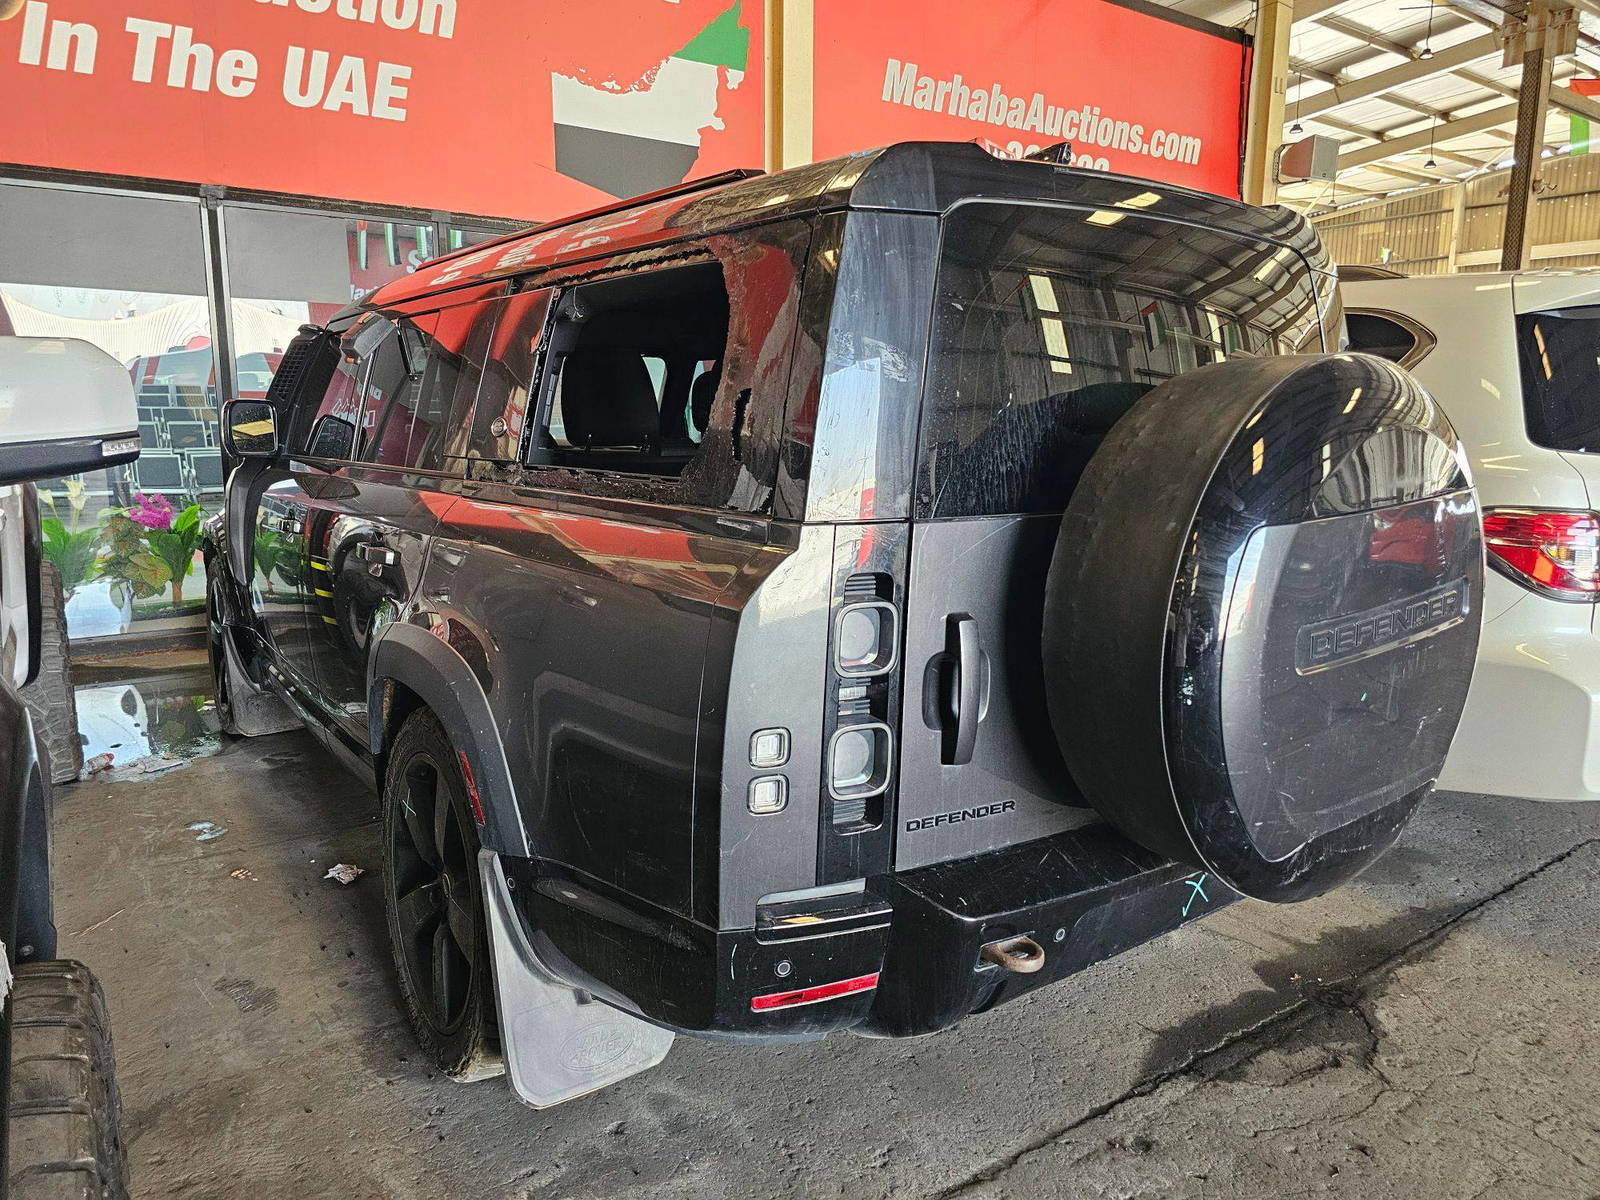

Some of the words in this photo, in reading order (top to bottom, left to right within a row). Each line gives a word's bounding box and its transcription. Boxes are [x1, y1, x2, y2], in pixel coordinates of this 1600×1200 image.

[18, 1, 98, 74] In
[126, 17, 258, 97] The
[283, 46, 412, 122] UAE
[881, 58, 1201, 165] MarhabaAuctions.com
[1310, 590, 1458, 660] DEFENDER
[905, 800, 1017, 832] DEFENDER
